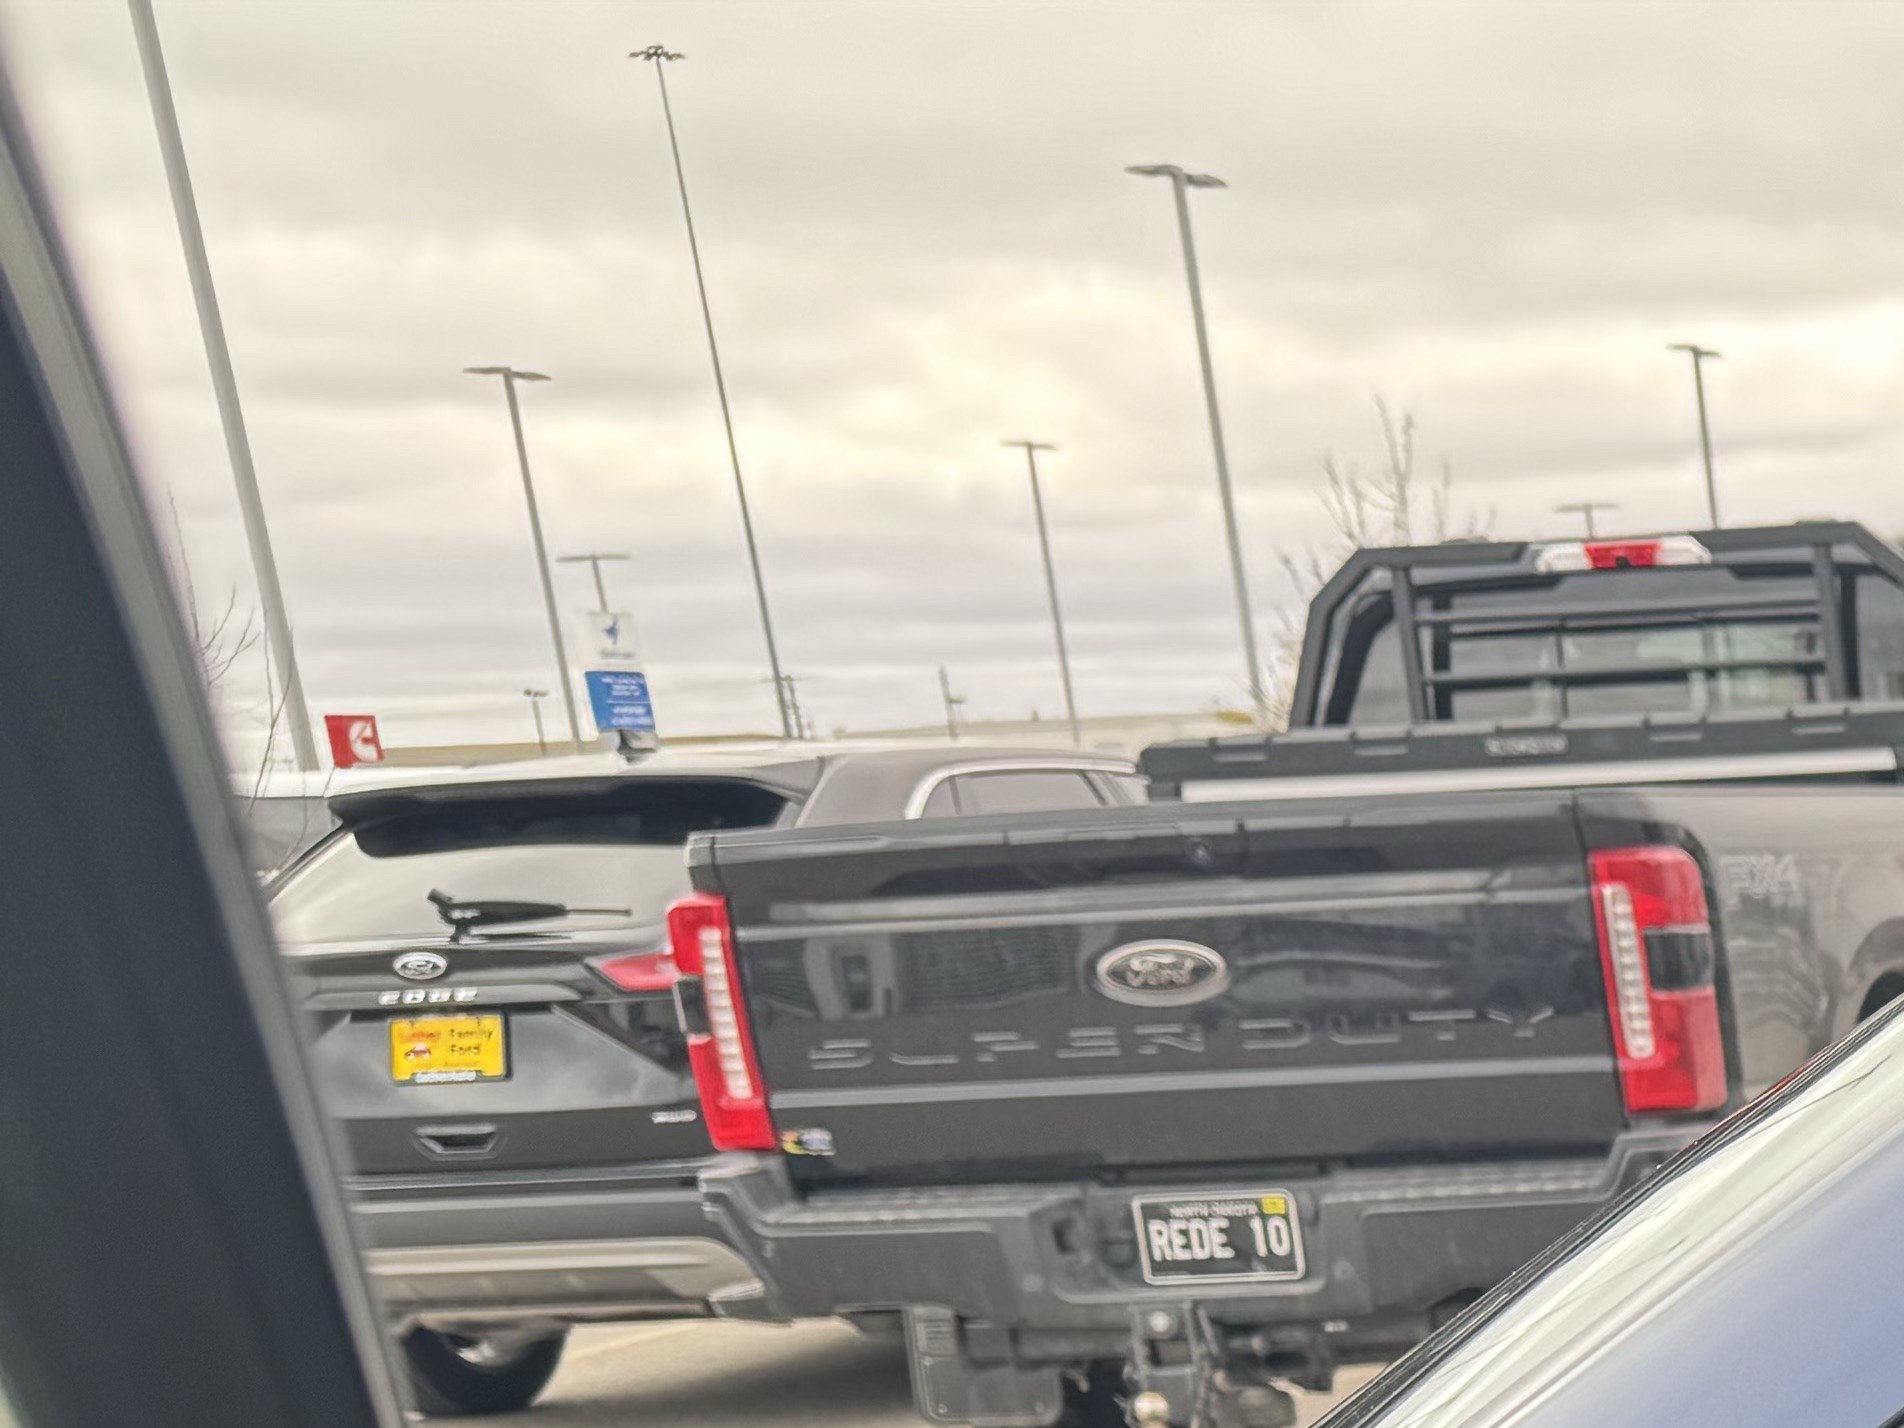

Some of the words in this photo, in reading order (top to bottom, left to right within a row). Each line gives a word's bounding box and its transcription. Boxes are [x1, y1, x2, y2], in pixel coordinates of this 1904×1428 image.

[1239, 1006, 1554, 1050] DUTY
[1148, 1218, 1236, 1262] REDE
[1250, 1215, 1291, 1258] 10
